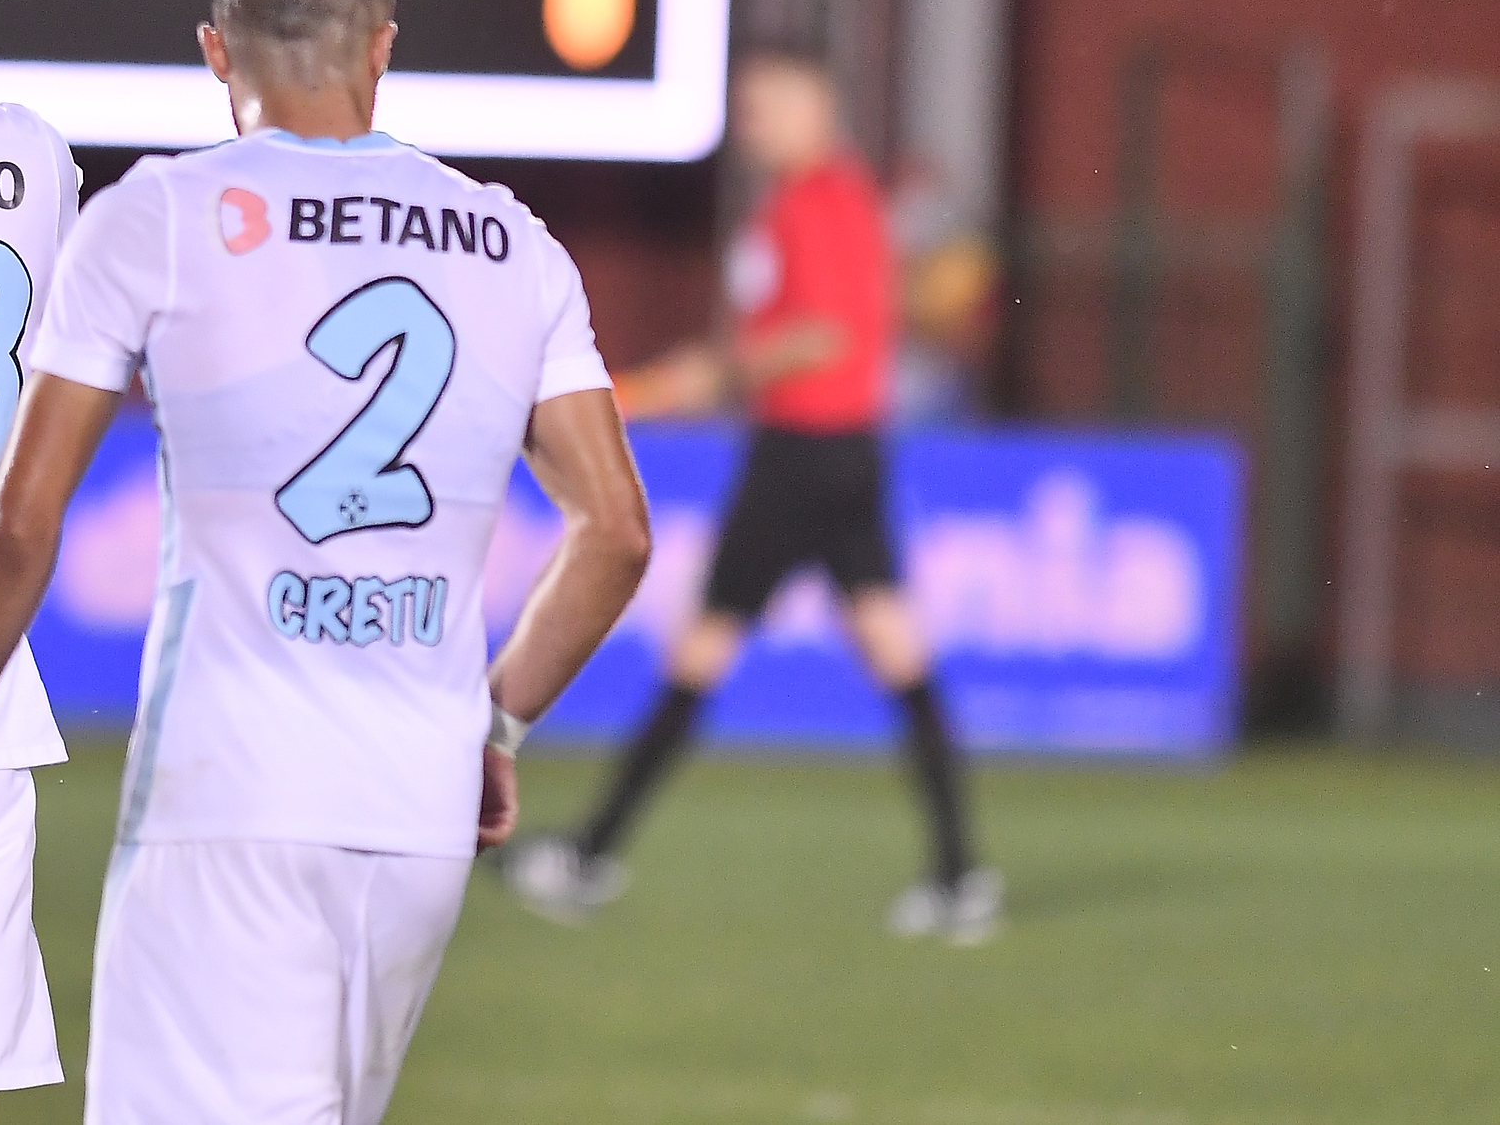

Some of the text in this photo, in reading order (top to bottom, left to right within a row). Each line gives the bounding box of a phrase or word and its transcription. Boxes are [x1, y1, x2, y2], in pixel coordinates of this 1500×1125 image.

[289, 196, 510, 263] BETANO
[274, 275, 457, 545] 2
[267, 569, 449, 648] CRETU
